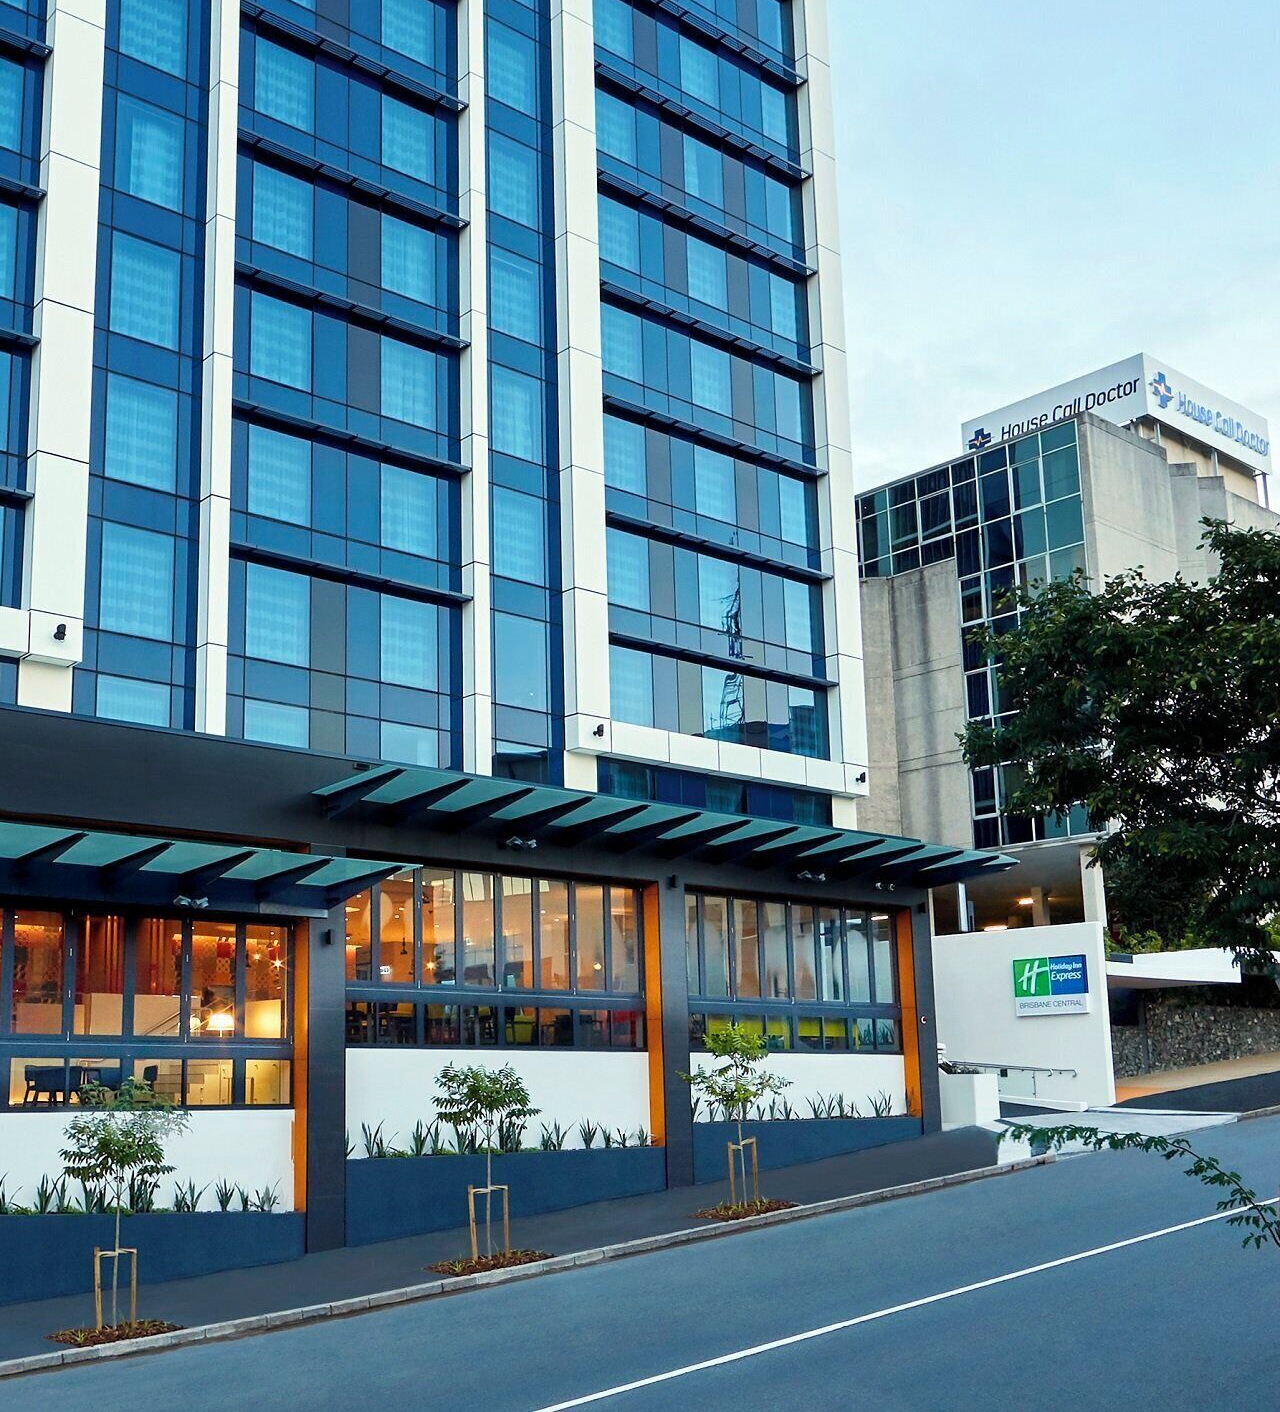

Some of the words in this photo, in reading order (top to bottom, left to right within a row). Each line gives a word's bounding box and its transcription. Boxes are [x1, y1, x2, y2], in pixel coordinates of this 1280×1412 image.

[1001, 413, 1049, 441] House
[1052, 397, 1081, 423] Call
[1084, 377, 1140, 411] Doctor
[1176, 391, 1213, 427] House
[1214, 411, 1234, 439] Call
[1234, 421, 1270, 457] Doctor
[1050, 962, 1073, 971] Holiday
[1072, 961, 1083, 969] Inn
[1051, 971, 1082, 982] Express
[1019, 1000, 1052, 1009] BRISBANE
[1052, 999, 1083, 1008] CENTRAL
